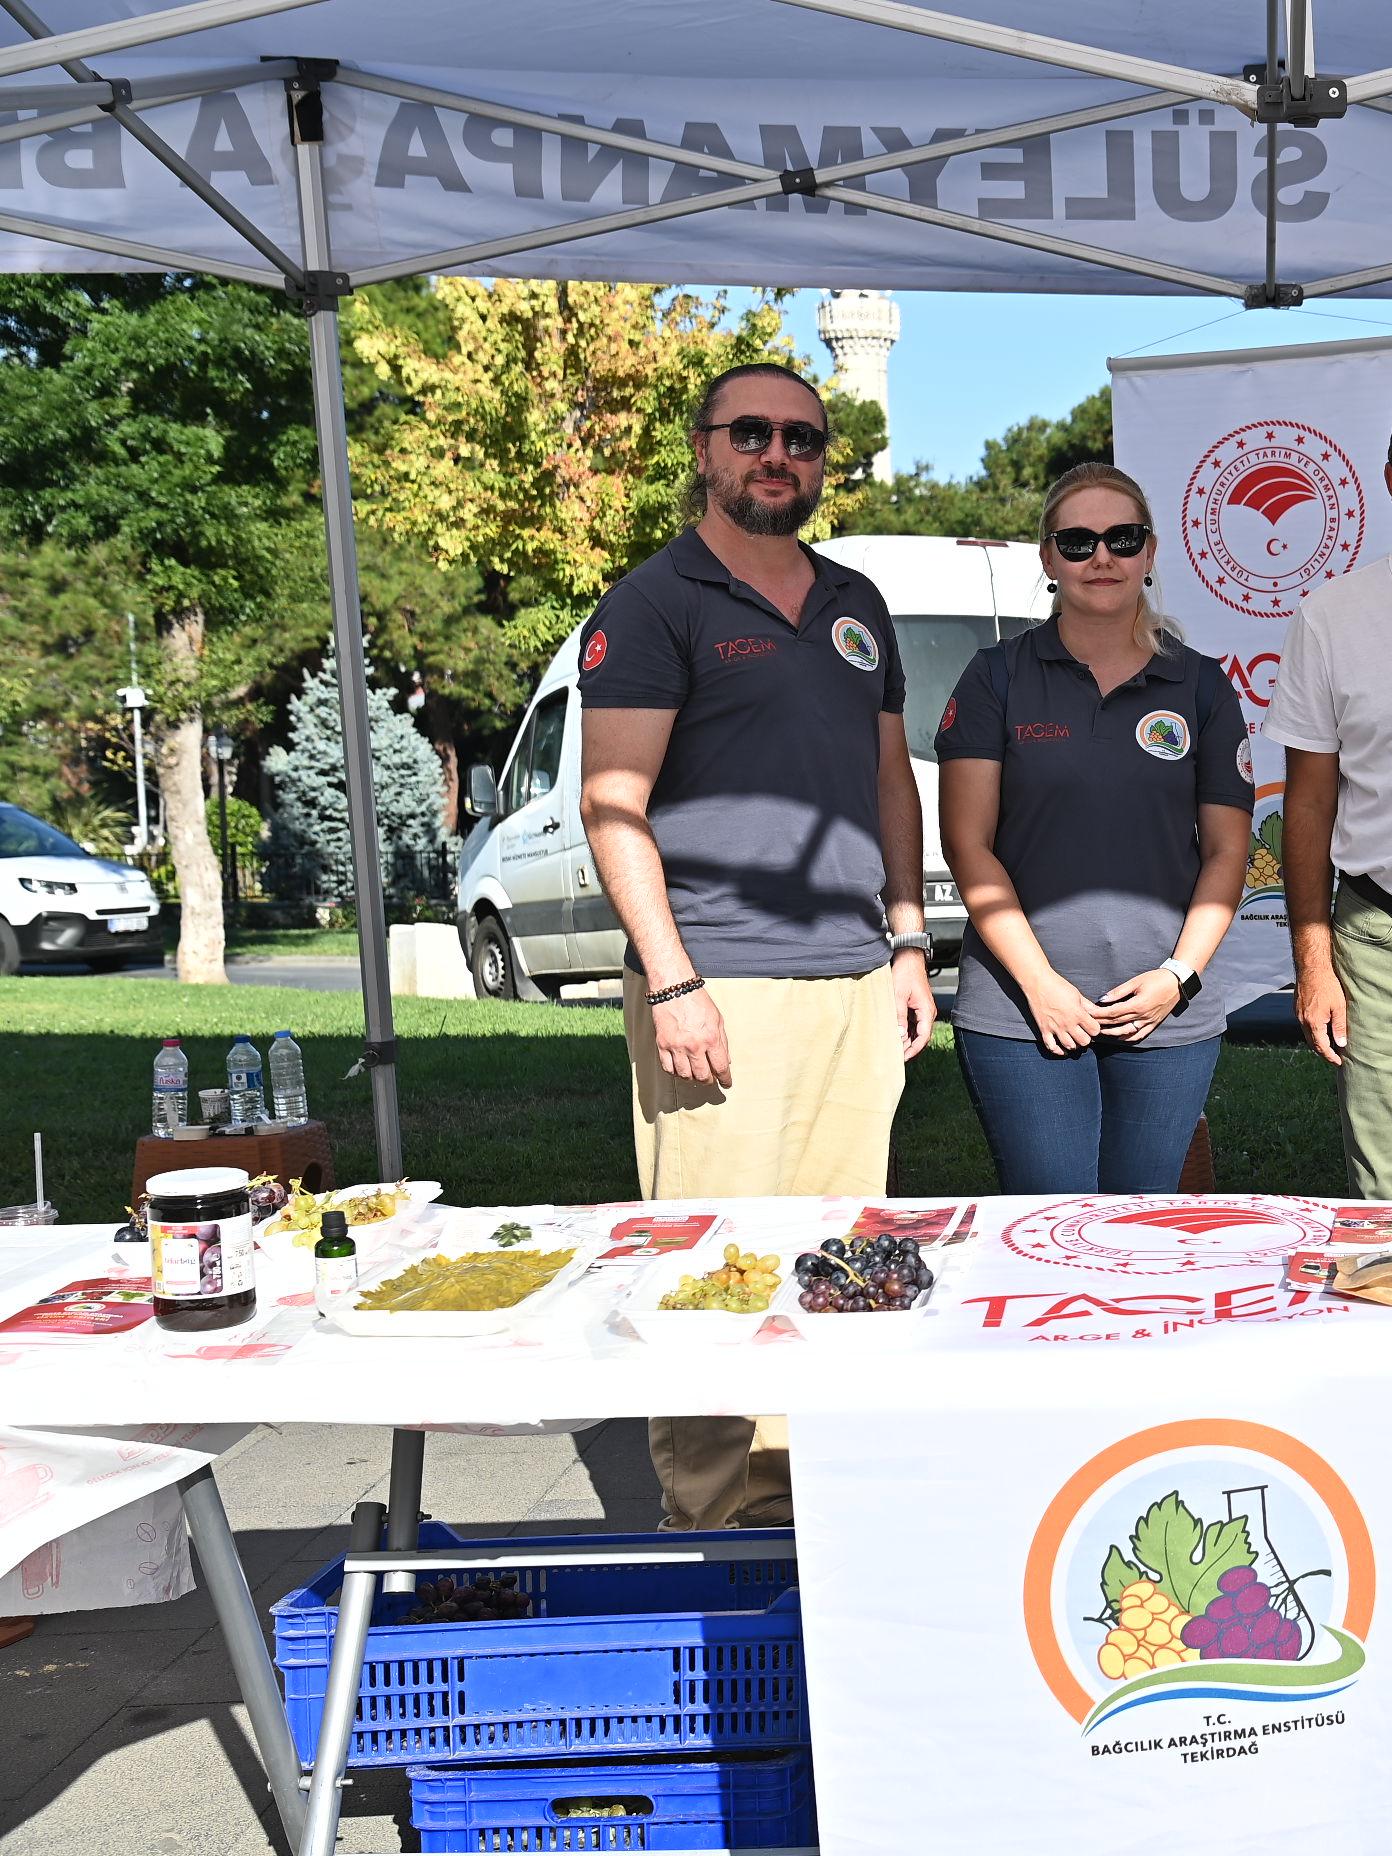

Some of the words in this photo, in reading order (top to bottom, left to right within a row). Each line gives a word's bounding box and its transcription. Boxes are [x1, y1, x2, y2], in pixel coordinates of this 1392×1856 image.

[1254, 449, 1292, 462] TARIM
[1297, 455, 1312, 469] VE
[1209, 455, 1252, 534] CUMHURİYETİ
[1312, 468, 1337, 511] ORMAN
[1213, 540, 1251, 583] TÜRKİYE
[1298, 517, 1337, 580] BAKANLIĞI
[960, 1283, 1352, 1328] TAGE
[1028, 1332, 1121, 1342] AR-GE
[1131, 1328, 1152, 1339] &
[1090, 1738, 1164, 1757] BAĞCILIK
[1167, 1725, 1258, 1748] ARAŞTIRMA
[1262, 1709, 1346, 1736] ENSTİTÜSÜ
[1203, 1713, 1232, 1727] T.C.
[1180, 1741, 1259, 1764] TEKİRDAĞ
